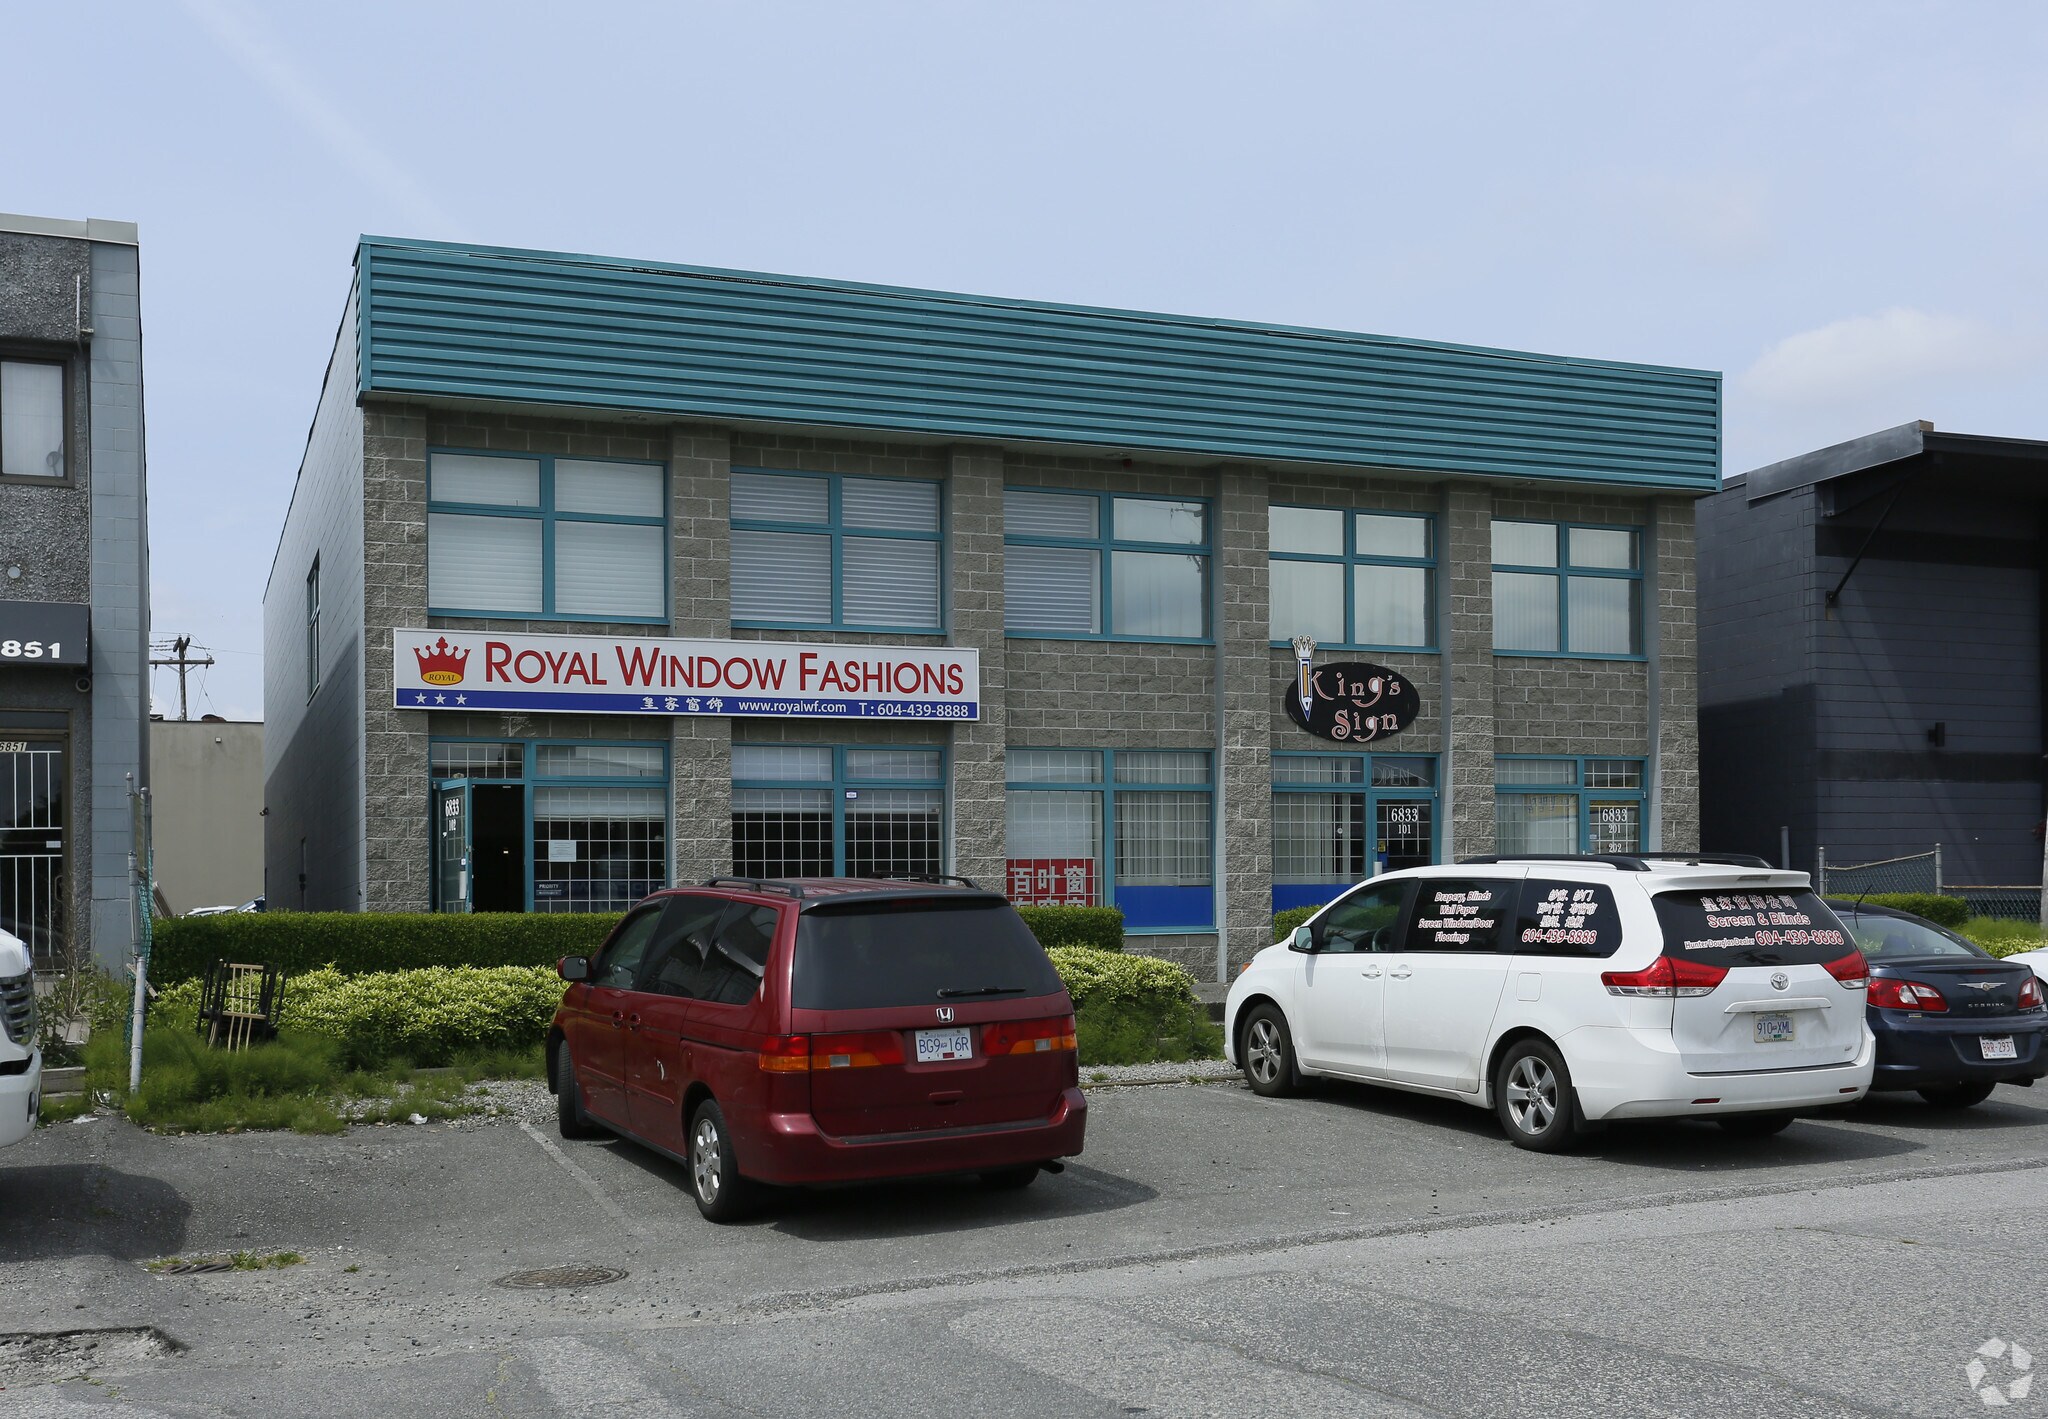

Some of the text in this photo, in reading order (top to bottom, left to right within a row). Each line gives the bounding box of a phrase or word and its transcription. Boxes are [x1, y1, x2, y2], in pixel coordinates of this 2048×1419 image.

[485, 641, 964, 695] ROYAL WINDOW FASHIONS
[428, 673, 456, 682] ROYAL
[738, 700, 847, 715] www.royalwf.com
[877, 704, 969, 718] 604-439-8888
[1331, 709, 1399, 742] Sign
[1372, 767, 1410, 786] OPEN
[445, 798, 460, 817] 6833
[1391, 808, 1418, 822] 6833
[1602, 808, 1628, 822] 6833
[1398, 824, 1411, 834] 101
[1608, 824, 1621, 834] 201
[1608, 842, 1622, 853] 202
[1010, 865, 1087, 894] 百叶窗
[1434, 890, 1492, 903] Drapery, Blinds
[1440, 904, 1479, 916] Wall Paper
[1418, 918, 1442, 928] Screen
[1707, 912, 1811, 928] Screen & Blinds
[1435, 931, 1469, 944] Floorings
[1522, 929, 1597, 944] 604-439-8888
[1684, 930, 1844, 950] Hunter Douglas Dealer 604-439-8888
